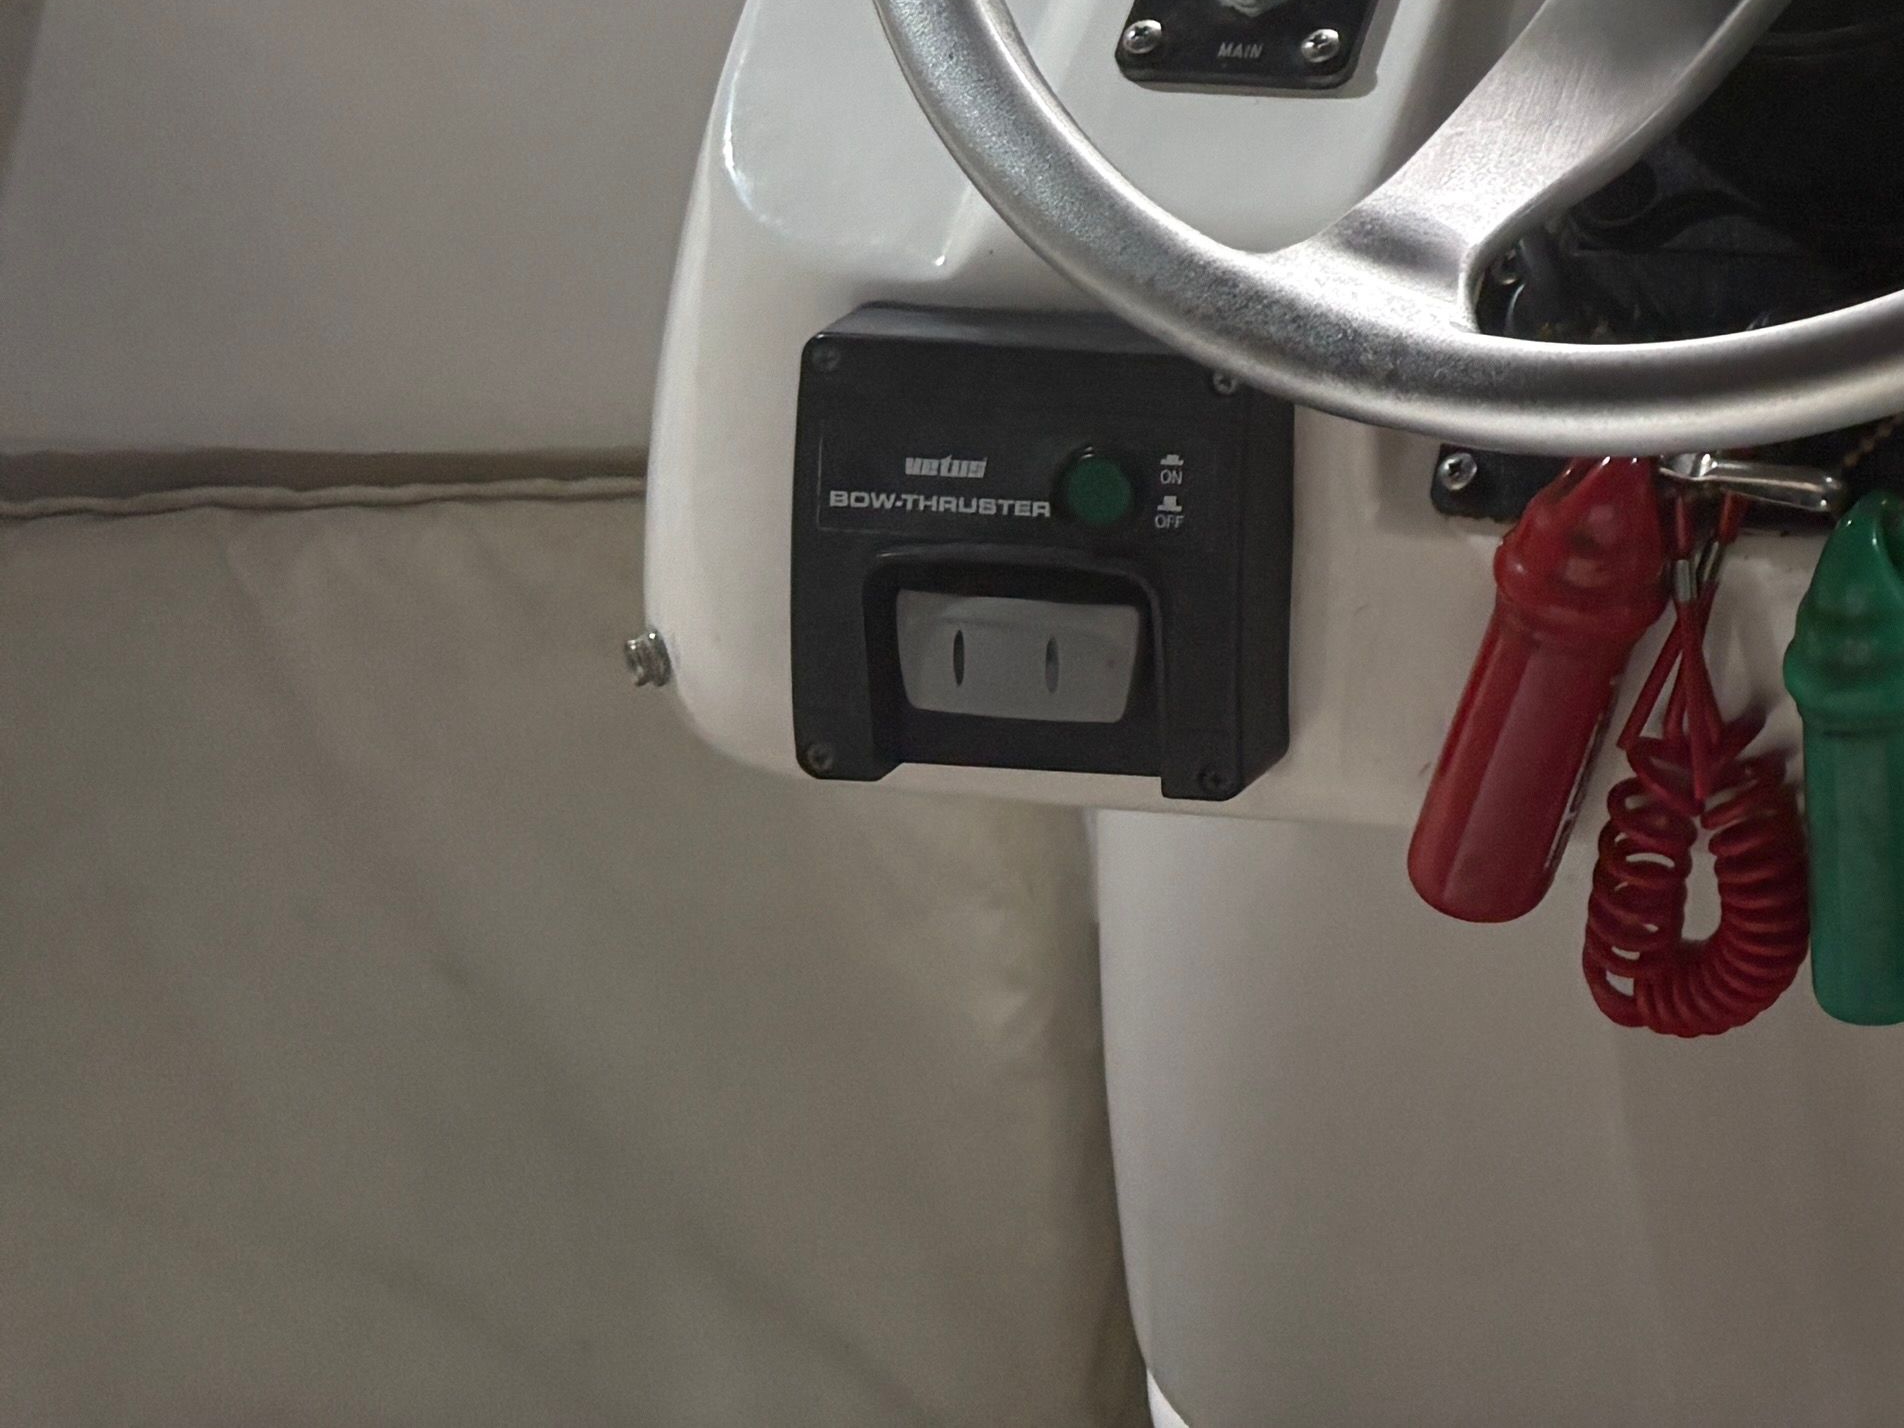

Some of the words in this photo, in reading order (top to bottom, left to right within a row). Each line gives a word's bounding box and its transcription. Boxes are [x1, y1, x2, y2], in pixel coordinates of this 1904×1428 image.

[1217, 43, 1263, 58] MAIN
[905, 456, 988, 479] vetus
[1160, 470, 1183, 485] ON
[829, 490, 1051, 518] BOW-THRUSTER
[1154, 515, 1185, 530] OFF
